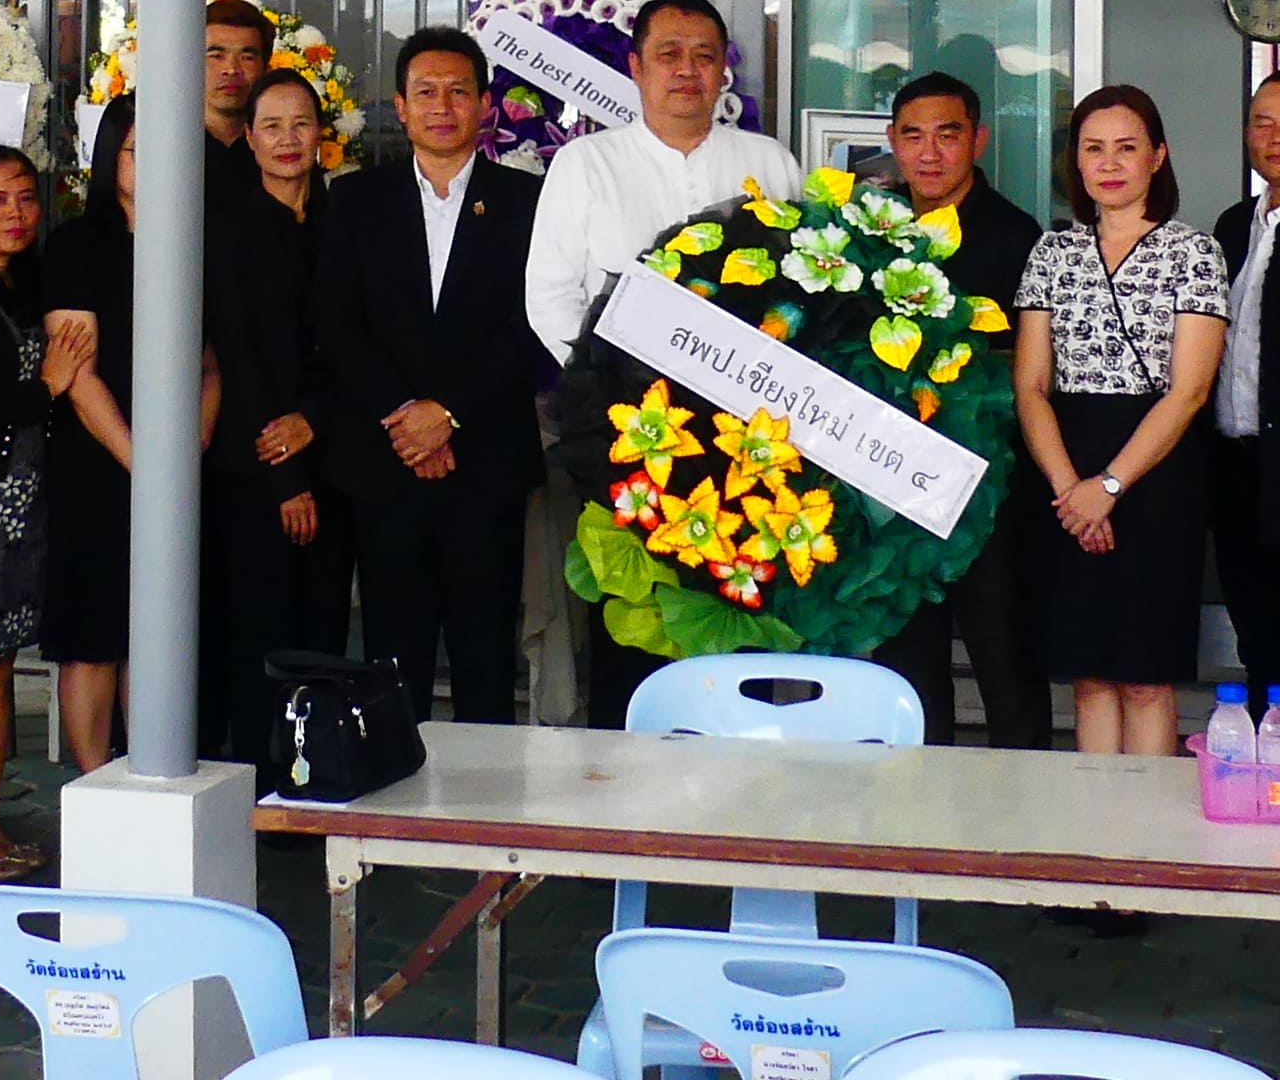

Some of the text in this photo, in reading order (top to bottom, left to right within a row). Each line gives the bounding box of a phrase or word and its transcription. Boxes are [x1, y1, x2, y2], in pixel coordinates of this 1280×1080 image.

[494, 30, 639, 124] The best Homes
[854, 432, 905, 475] เขต
[911, 469, 941, 492] ๔
